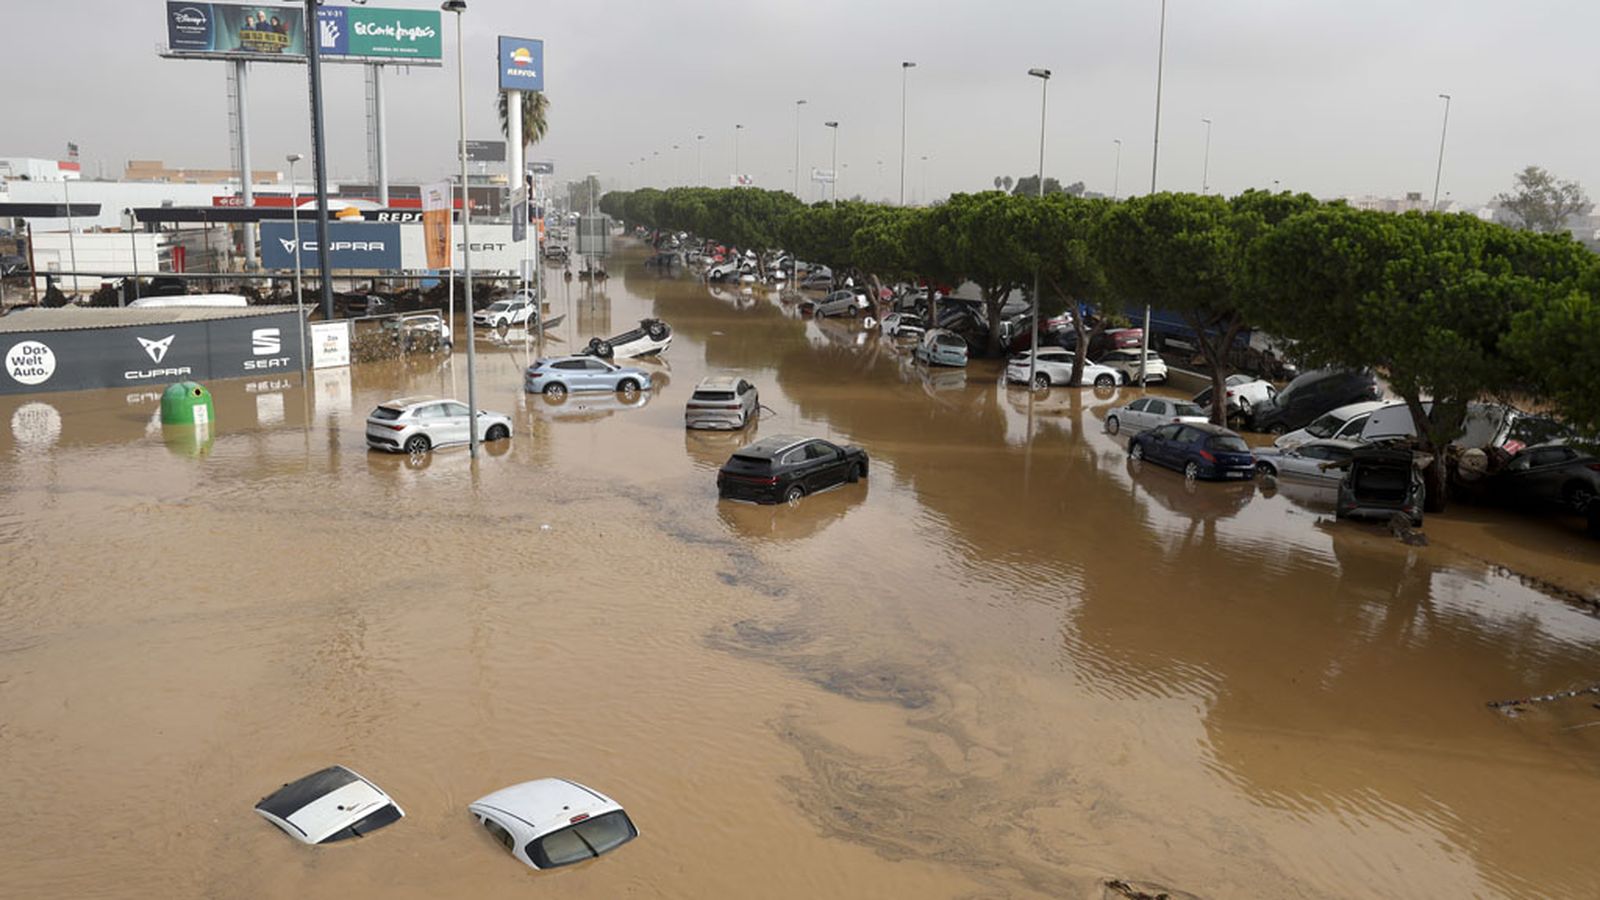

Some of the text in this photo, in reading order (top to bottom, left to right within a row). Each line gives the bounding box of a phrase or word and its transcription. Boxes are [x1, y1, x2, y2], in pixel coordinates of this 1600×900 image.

[367, 23, 395, 36] Corte
[395, 21, 435, 41] Inglés
[377, 212, 424, 222] REPS
[457, 243, 506, 251] SEAT
[22, 345, 48, 355] Das
[11, 355, 43, 366] Welt
[243, 357, 291, 370] SEAT
[13, 367, 49, 376] Auto.
[124, 366, 191, 379] CUPRA
